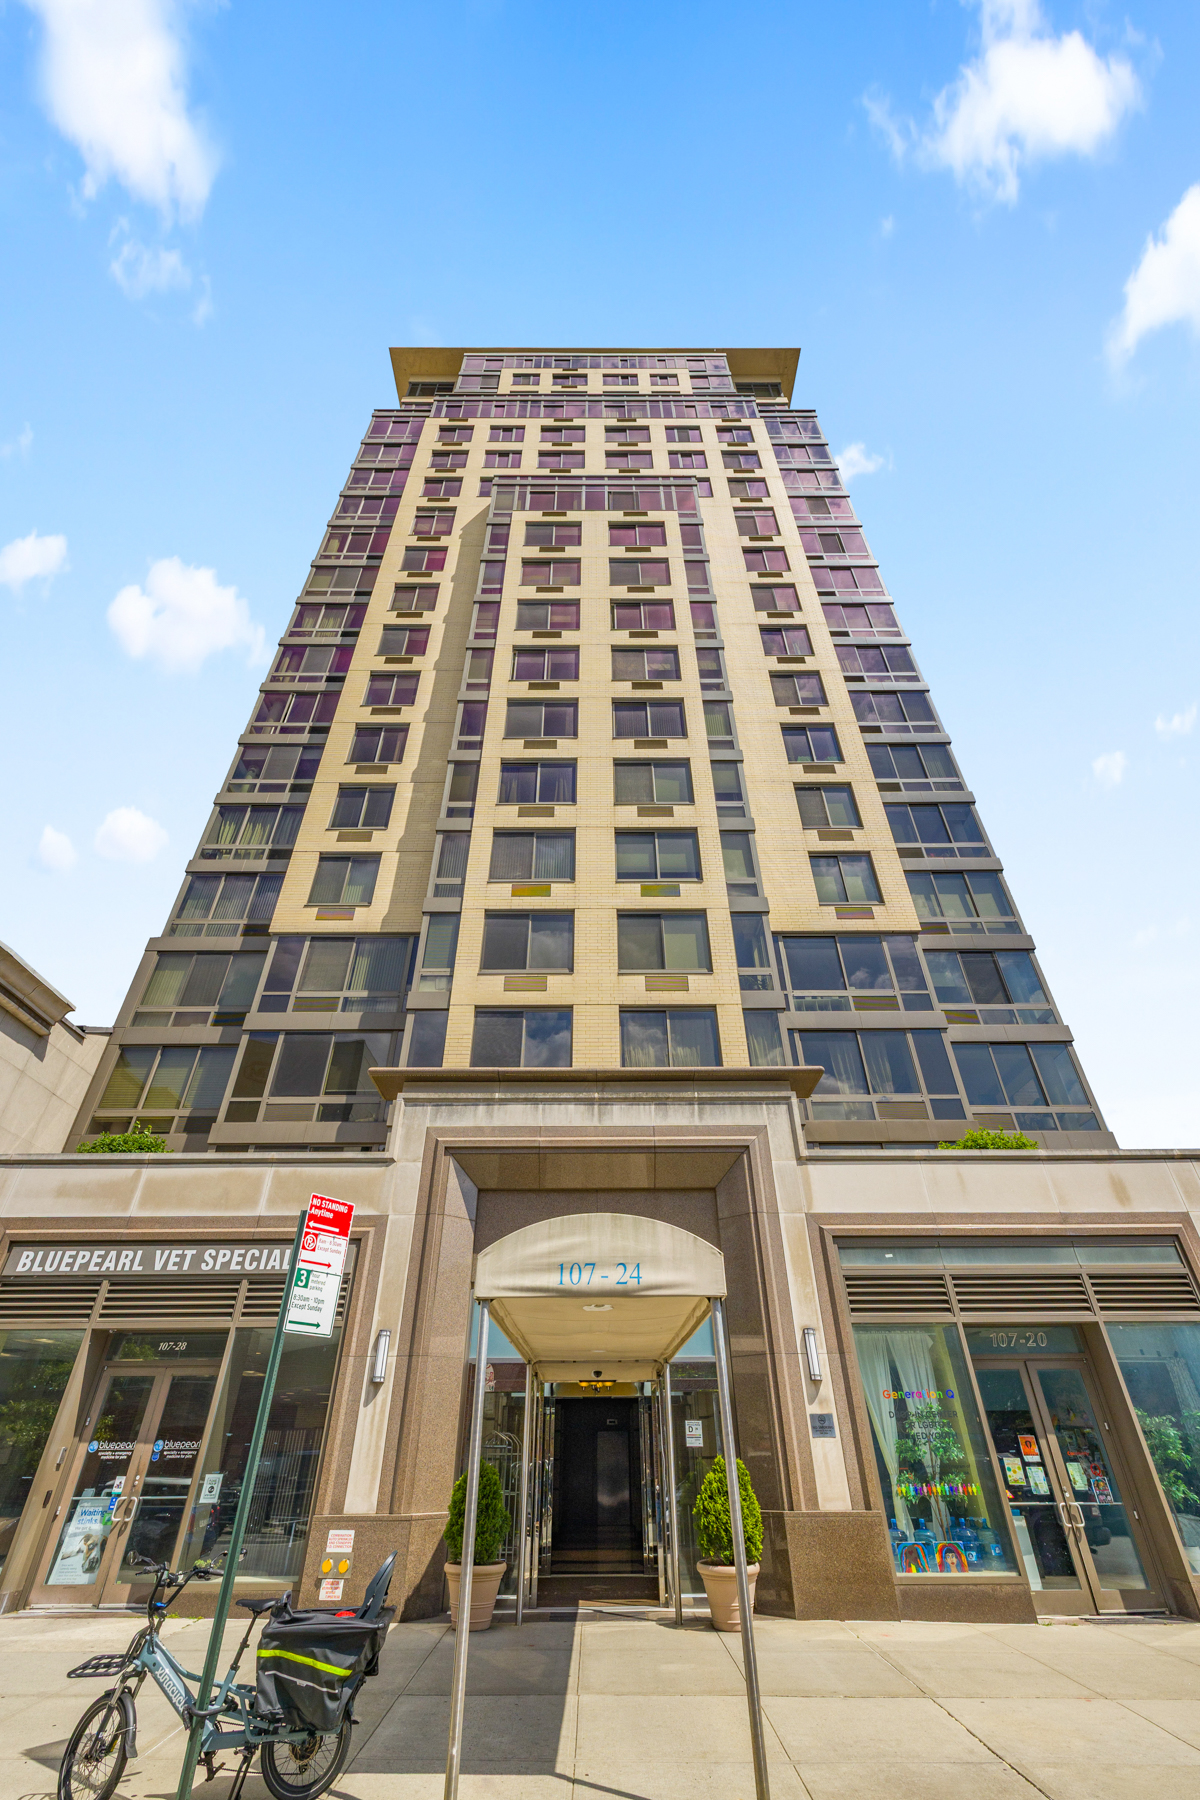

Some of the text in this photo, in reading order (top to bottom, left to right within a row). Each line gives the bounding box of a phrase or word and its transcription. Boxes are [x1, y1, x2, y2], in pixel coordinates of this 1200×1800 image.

[312, 1197, 348, 1213] NO STANDING
[310, 1206, 334, 1219] Anytime
[317, 1245, 342, 1255] Except Sunday
[15, 1250, 144, 1272] BLUEPEARL
[154, 1249, 197, 1271] VET
[297, 1269, 307, 1287] 3
[310, 1278, 326, 1286] metered
[309, 1284, 323, 1293] parking
[292, 1293, 310, 1303] 8:30am
[313, 1296, 325, 1305] 10pm
[290, 1301, 323, 1314] Except Sunday
[989, 1332, 1048, 1347] 107-20
[158, 1341, 188, 1351] 107-28
[882, 1388, 955, 1399] Generation Q
[99, 1440, 137, 1449] bluepearl
[164, 1439, 201, 1449] bluepearl
[80, 1509, 108, 1518] Waiting
[155, 1666, 189, 1713] xtracycl
